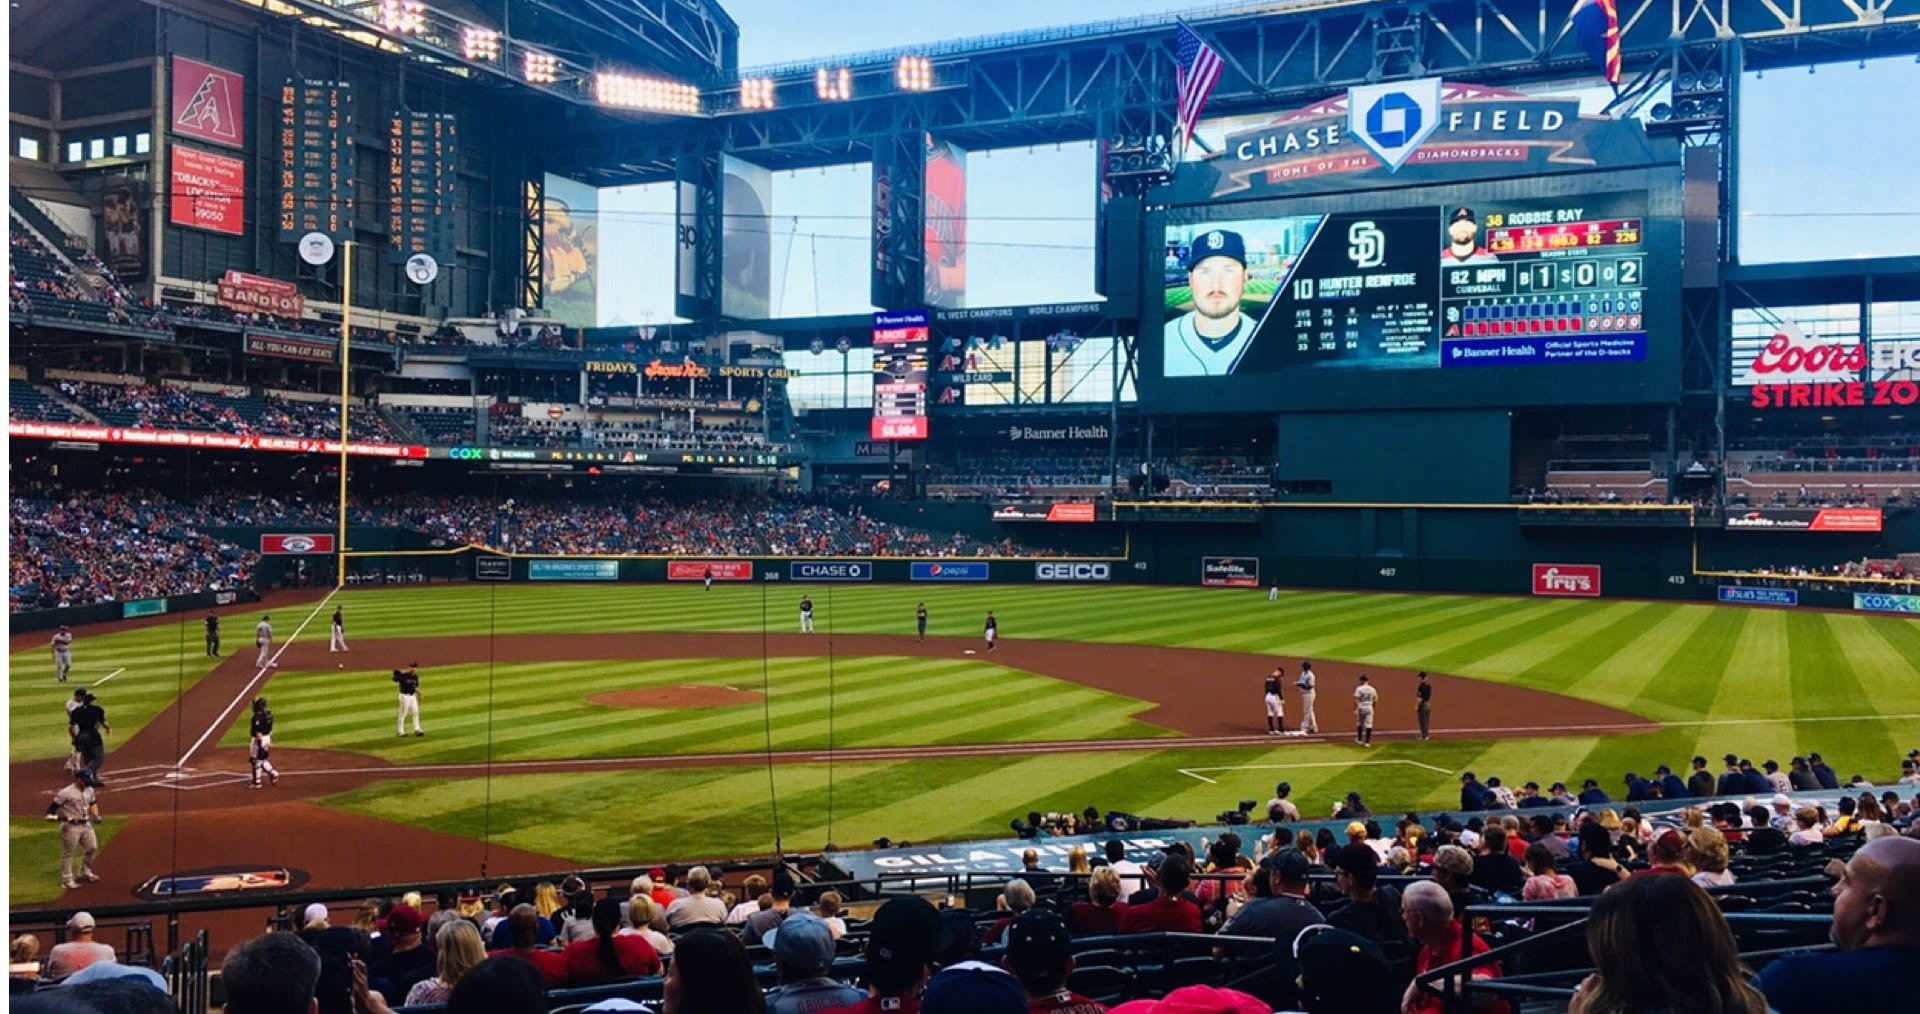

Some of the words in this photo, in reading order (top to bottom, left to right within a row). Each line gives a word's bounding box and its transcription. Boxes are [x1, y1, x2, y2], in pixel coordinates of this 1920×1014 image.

[1237, 125, 1340, 162] CHASE
[1449, 110, 1565, 132] FIELD
[1272, 167, 1308, 179] HOME
[1318, 162, 1334, 171] OF
[1344, 157, 1368, 167] THE
[1417, 148, 1521, 161] DIAMONDBACKS
[1486, 214, 1503, 228] 38
[1508, 210, 1554, 226] ROBBIE
[1557, 208, 1584, 223] RAY
[1450, 269, 1469, 285] 82
[1476, 268, 1506, 283] MPH
[1519, 271, 1529, 286] B
[1539, 266, 1550, 287] 1
[1561, 269, 1571, 284] S
[1577, 263, 1594, 285] 0
[1620, 261, 1637, 284] 2
[1293, 278, 1314, 300] 10
[1319, 275, 1363, 290] HUNTER
[1365, 272, 1417, 288] RENFROE
[223, 286, 300, 311] SANDLOT
[969, 308, 1013, 319] CHAMPIONS
[1028, 306, 1053, 315] WORLD
[1055, 303, 1100, 314] CHAMPIONS
[1464, 347, 1500, 358] Banner
[1502, 345, 1536, 357] Health
[1574, 340, 1600, 350] Sports
[1584, 349, 1598, 357] the
[1752, 334, 1868, 374] Coors
[719, 367, 764, 378] SPORTS
[767, 368, 801, 379] GRILL
[1752, 385, 1865, 408] STRIKE
[1023, 426, 1066, 440] Banner
[1068, 424, 1109, 440] Health
[450, 448, 482, 460] COX
[1728, 517, 1775, 526] Safelite
[802, 565, 847, 577] CHASE
[943, 564, 969, 577] pepsi
[1036, 563, 1109, 580] GEICO
[1206, 564, 1245, 573] Safelite
[1380, 568, 1396, 577] 407
[1541, 567, 1591, 592] fry's
[1668, 575, 1685, 585] 413
[1864, 596, 1891, 608] COX
[873, 851, 1008, 868] GILA
